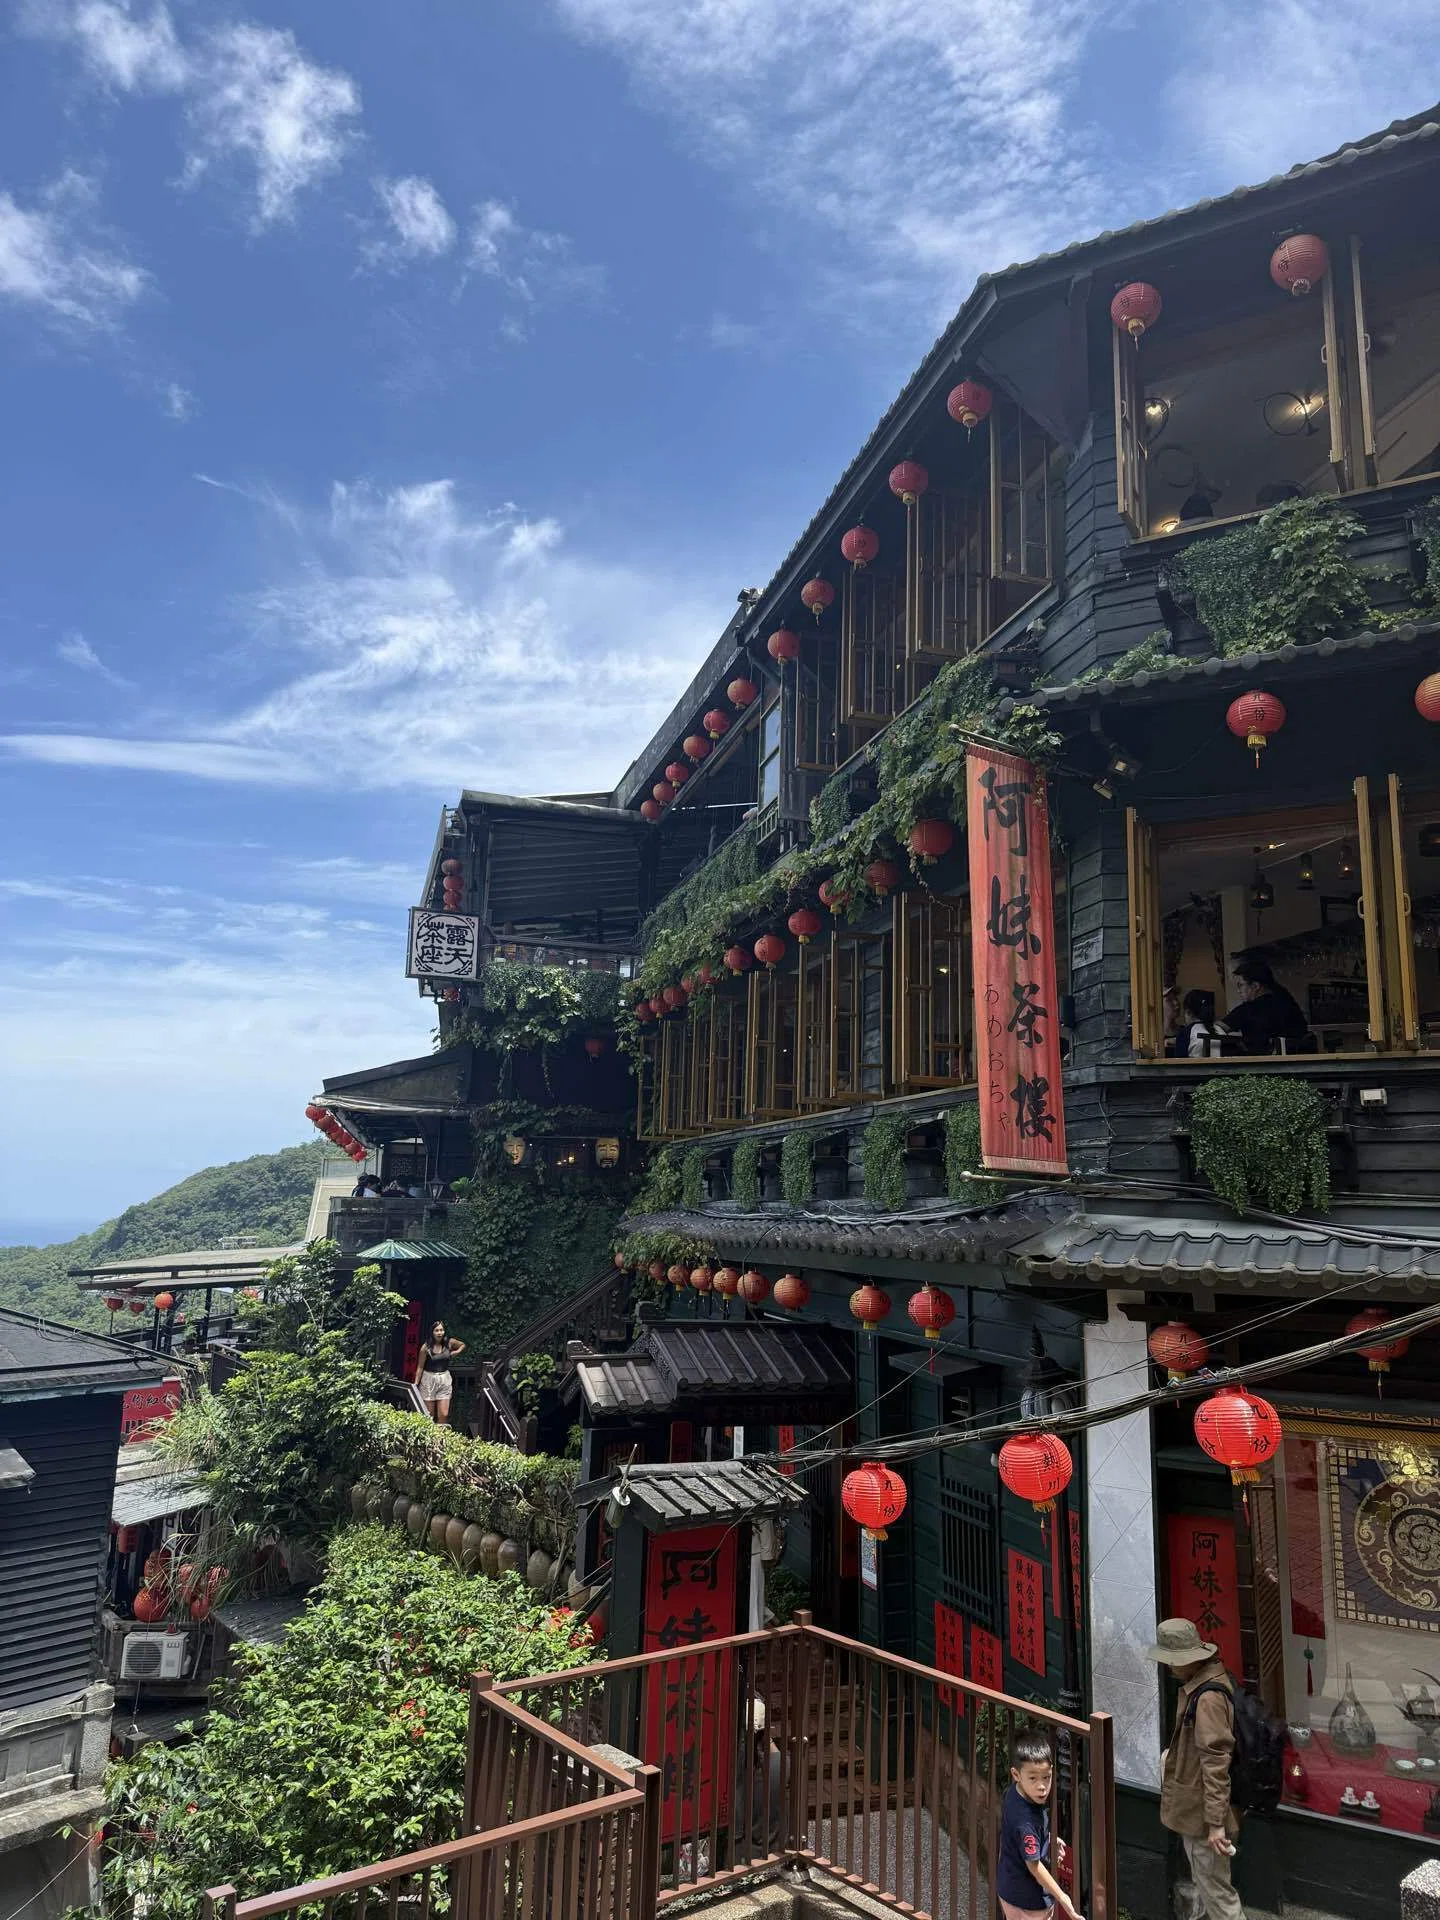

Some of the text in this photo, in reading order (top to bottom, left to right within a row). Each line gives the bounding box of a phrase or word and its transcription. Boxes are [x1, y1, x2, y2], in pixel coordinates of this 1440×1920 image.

[977, 766, 1057, 1144] 阿妹茶樓
[1250, 1404, 1271, 1454] 九份
[884, 1479, 901, 1518] 九份
[1188, 1530, 1227, 1645] 阿妹茶
[1024, 1834, 1036, 1855] 3
